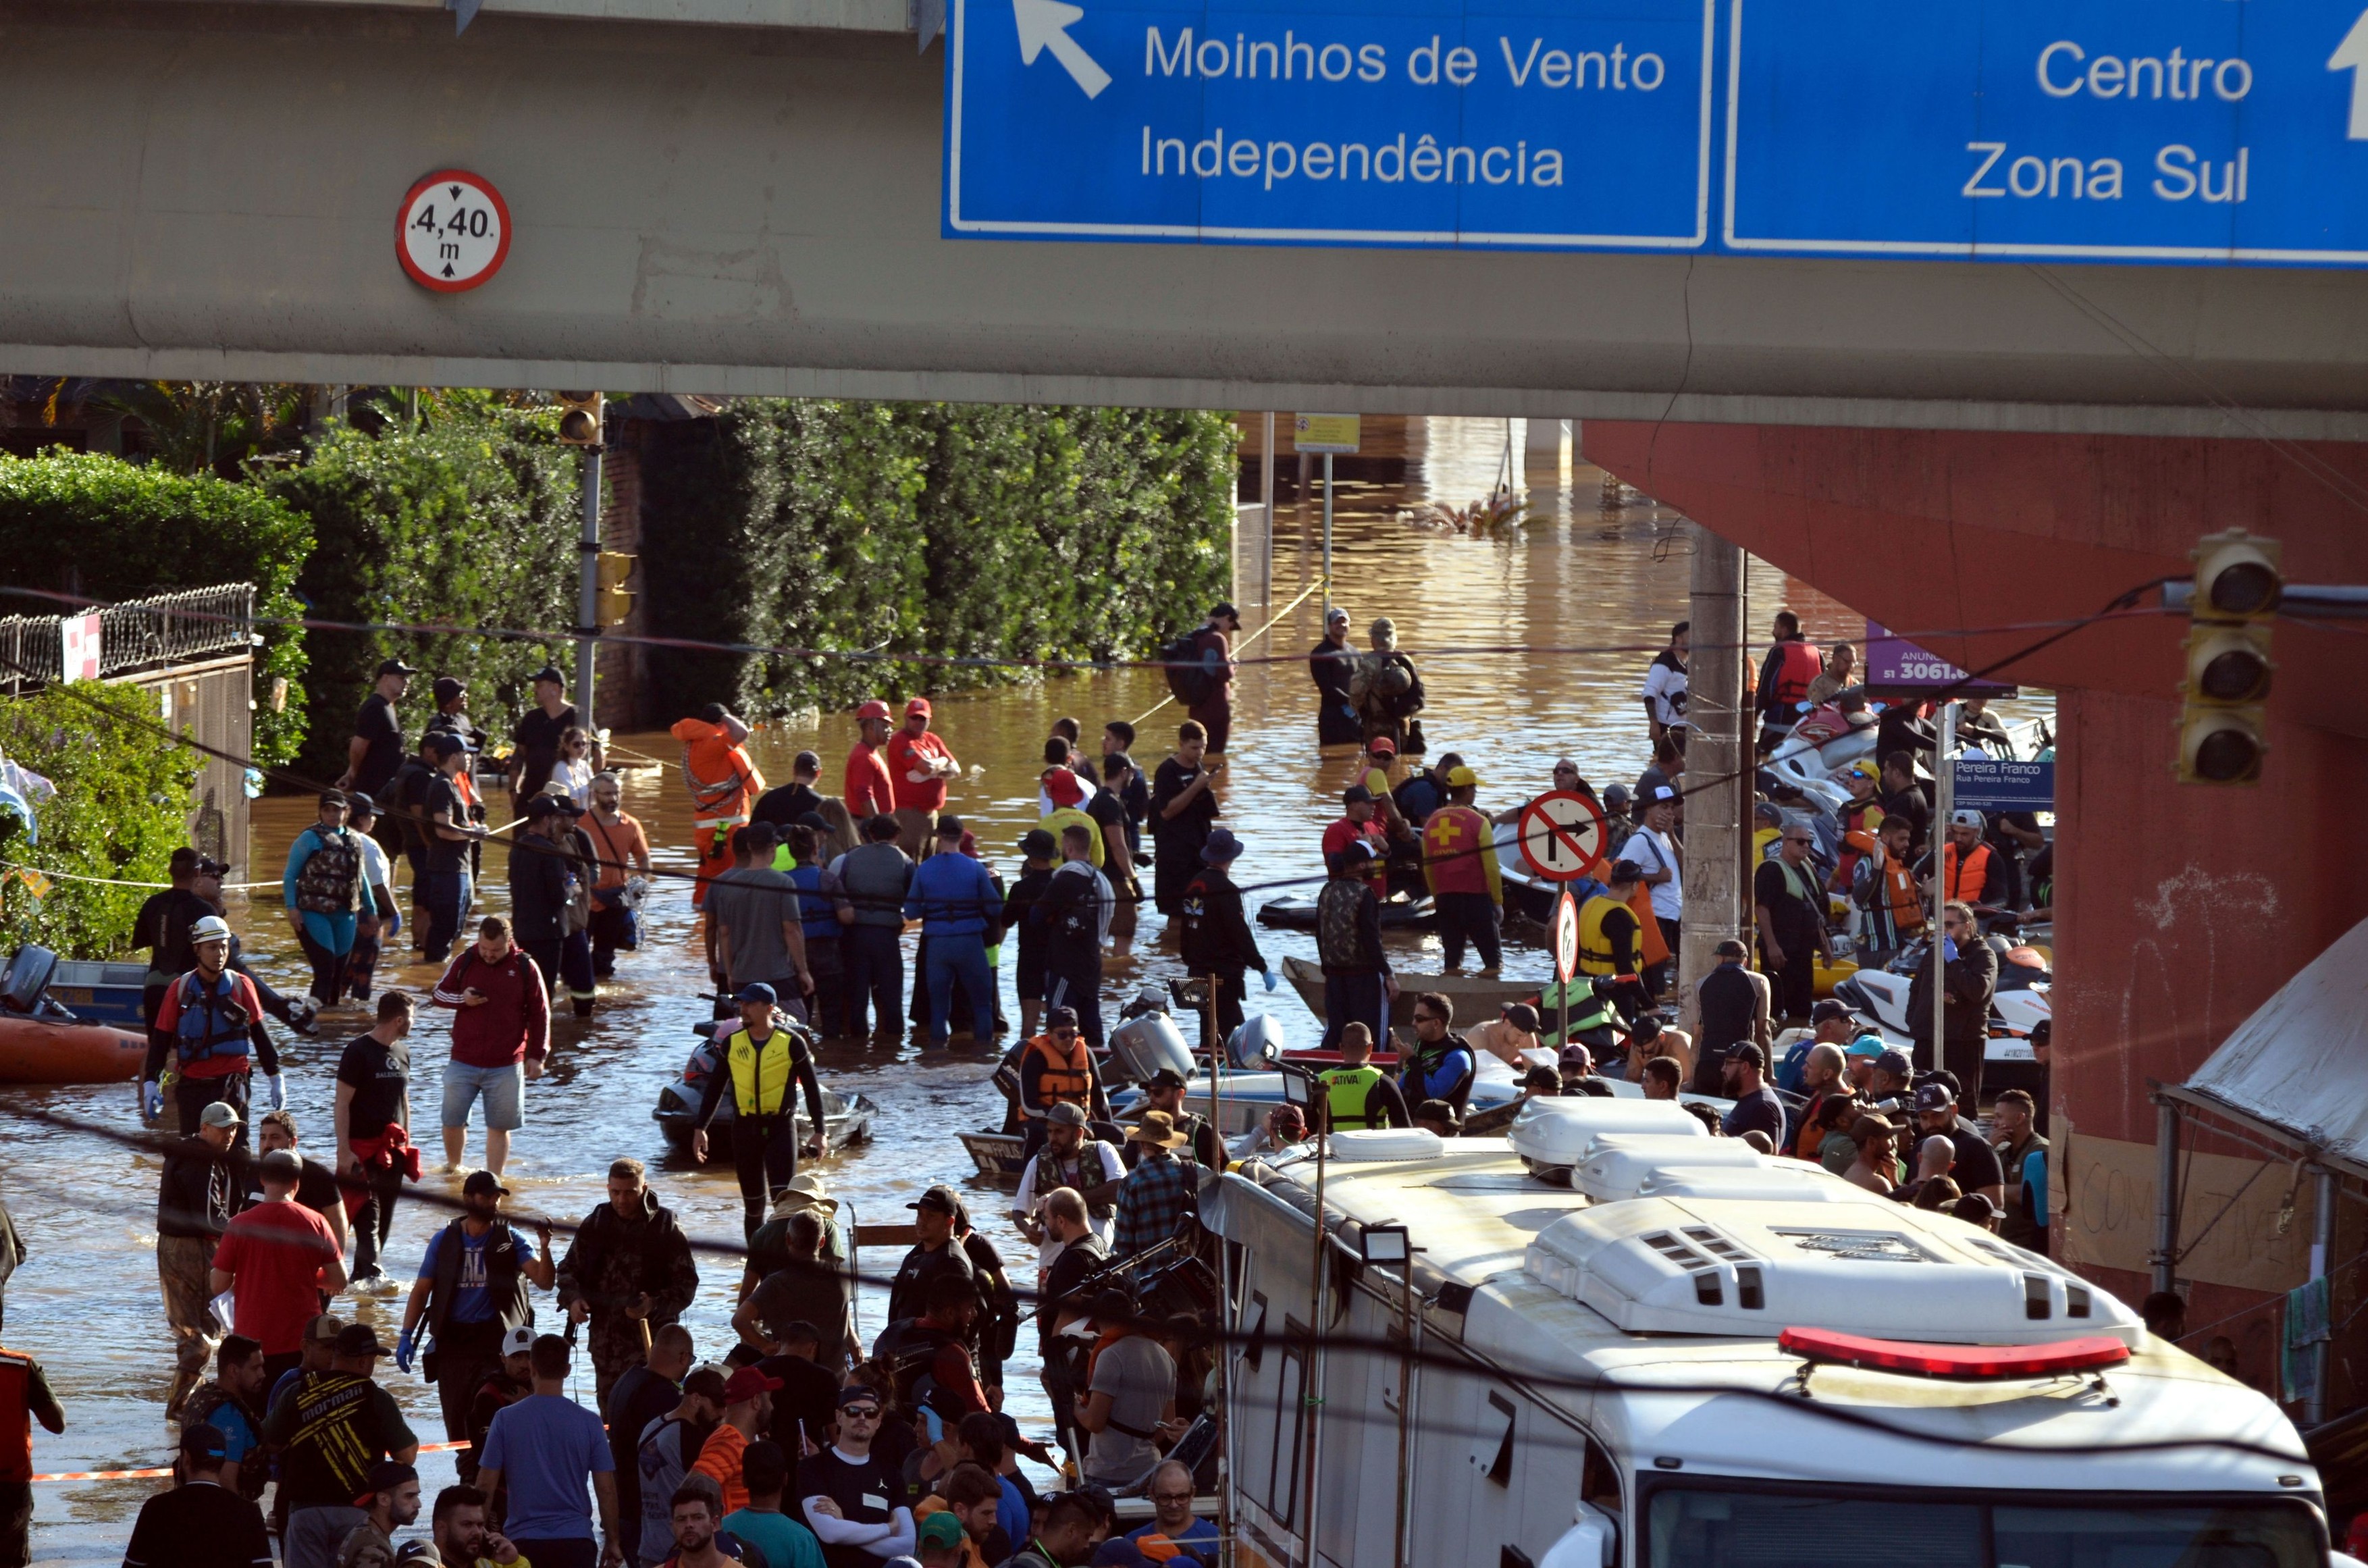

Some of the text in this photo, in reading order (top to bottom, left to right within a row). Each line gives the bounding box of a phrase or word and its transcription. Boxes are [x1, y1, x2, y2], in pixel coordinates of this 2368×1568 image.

[1145, 26, 1664, 90] Moinhos de Vento
[2038, 41, 2253, 100] Centro
[1142, 126, 1563, 190] Independência
[1962, 142, 2249, 202] Zona Sul
[416, 204, 488, 240] 4,40
[440, 243, 459, 260] m
[1884, 669, 1895, 679] 51
[1901, 652, 1942, 661] ANUNC
[1955, 762, 2041, 775] Pereira Franco
[1955, 775, 2030, 784] Rua Pereira Franco
[301, 1384, 364, 1423] mormaii
